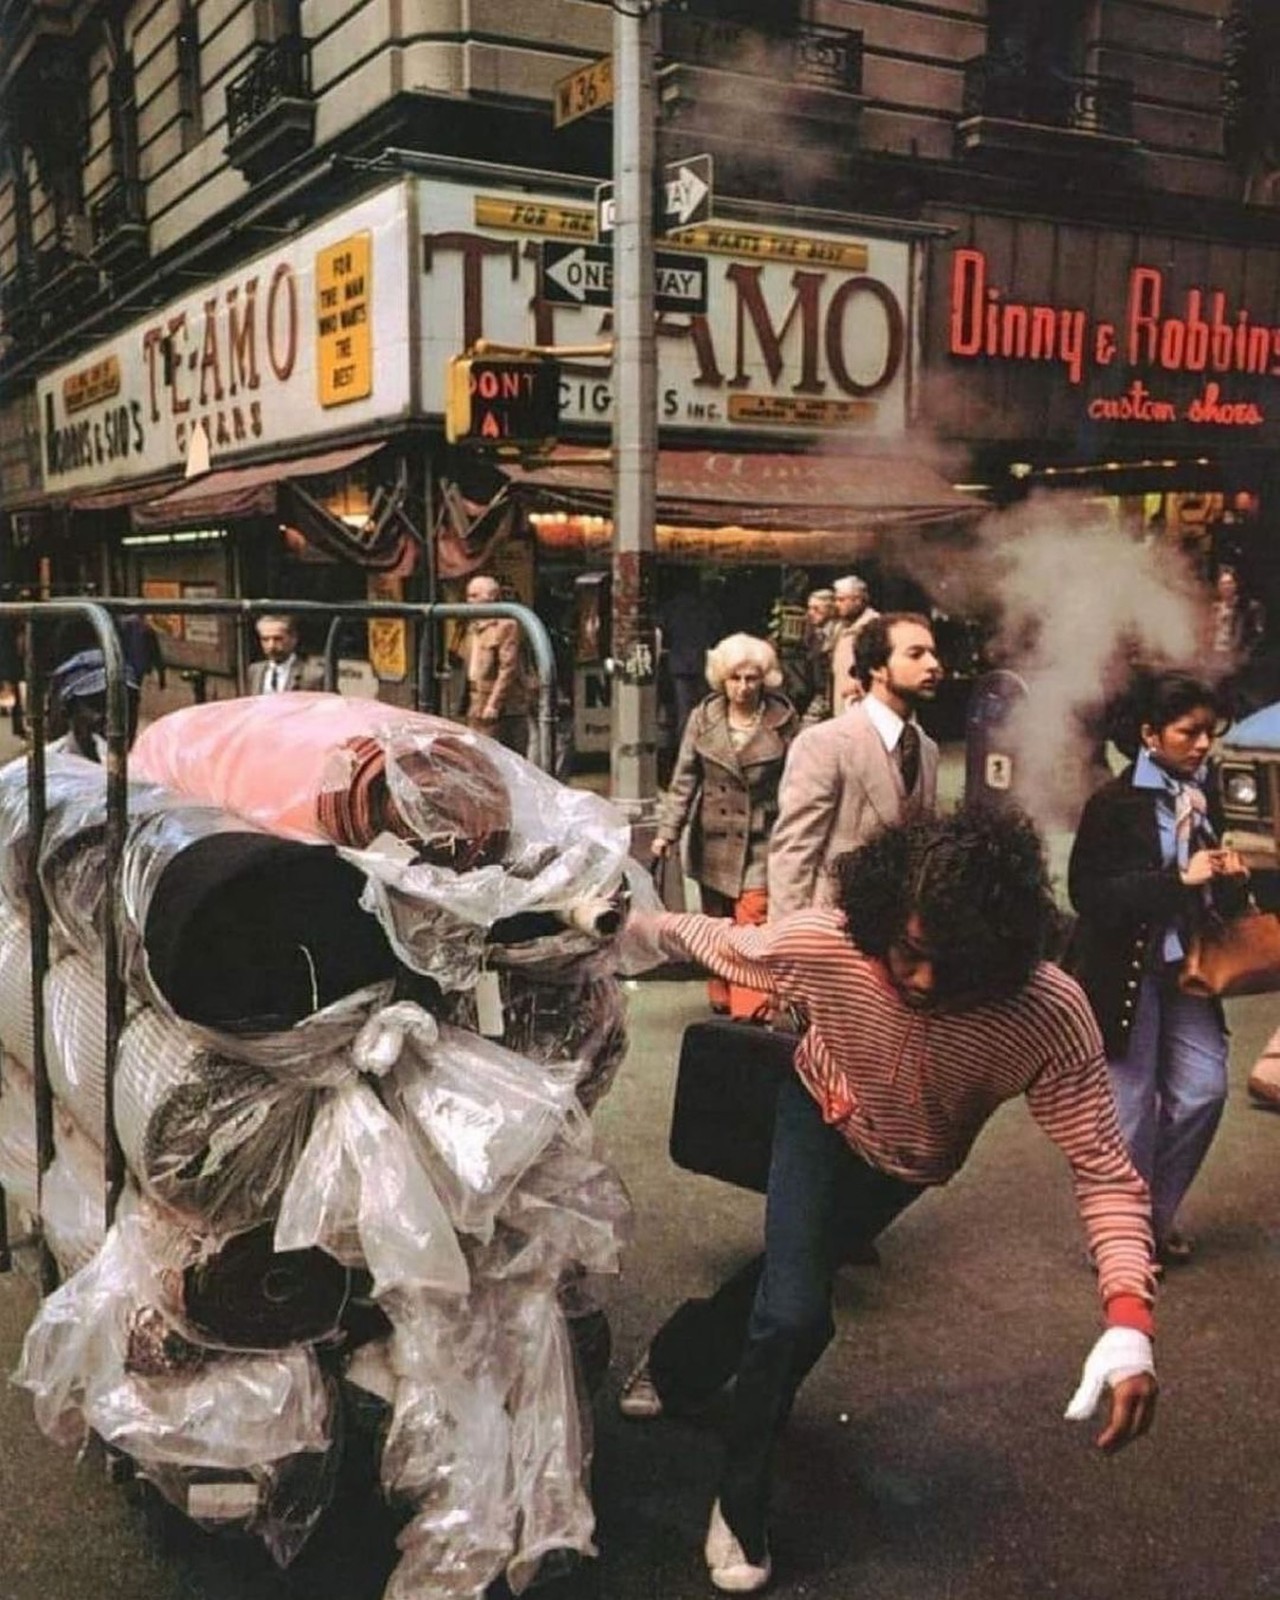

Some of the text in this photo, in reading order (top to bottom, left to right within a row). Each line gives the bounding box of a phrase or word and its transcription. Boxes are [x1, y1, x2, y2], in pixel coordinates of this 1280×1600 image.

[560, 81, 571, 117] W
[576, 71, 599, 111] 36
[511, 205, 548, 226] FOR
[559, 210, 595, 231] THE
[332, 251, 352, 278] FOR
[566, 262, 614, 287] ONE
[319, 286, 337, 308] THE
[951, 248, 1087, 384] Dinny
[1096, 324, 1117, 366] &
[335, 337, 352, 359] THE
[332, 364, 356, 389] BEST
[557, 382, 679, 416] CIGS
[1087, 380, 1264, 425] custom shoes
